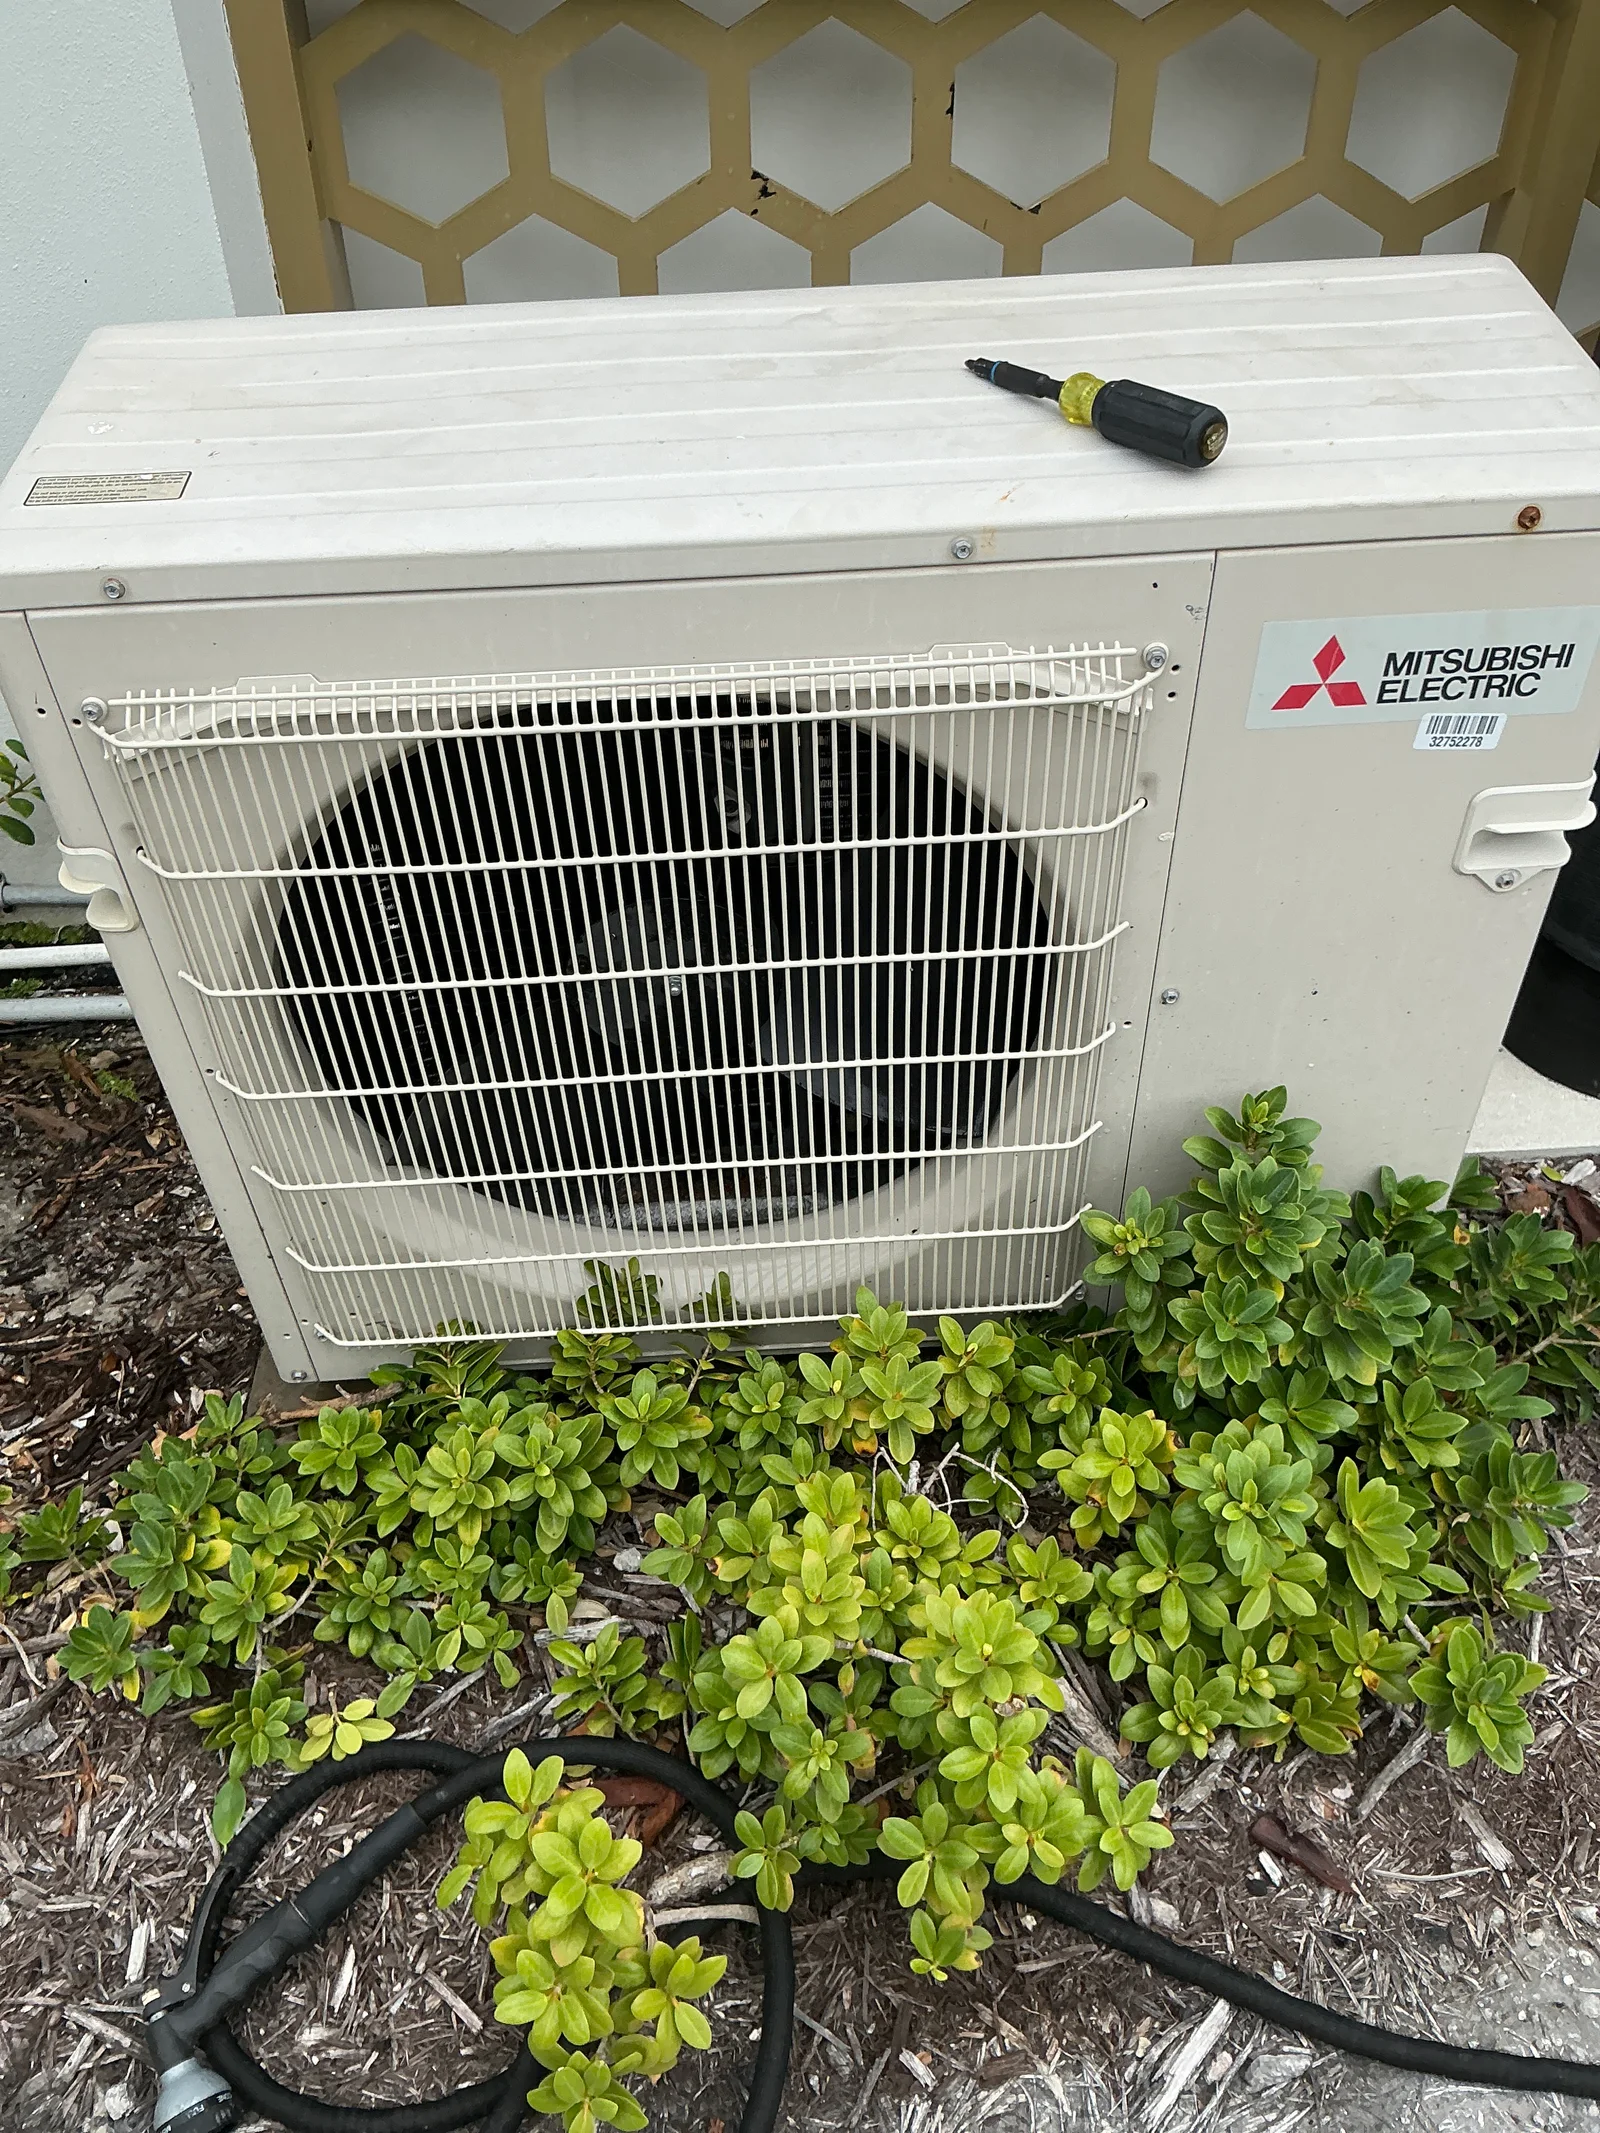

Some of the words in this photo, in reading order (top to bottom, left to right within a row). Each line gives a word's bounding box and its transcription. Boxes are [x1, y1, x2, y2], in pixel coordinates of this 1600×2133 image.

[1383, 643, 1576, 677] MITSUBISHI
[1376, 672, 1541, 704] ELECTRIC
[1429, 736, 1484, 748] 32752278
